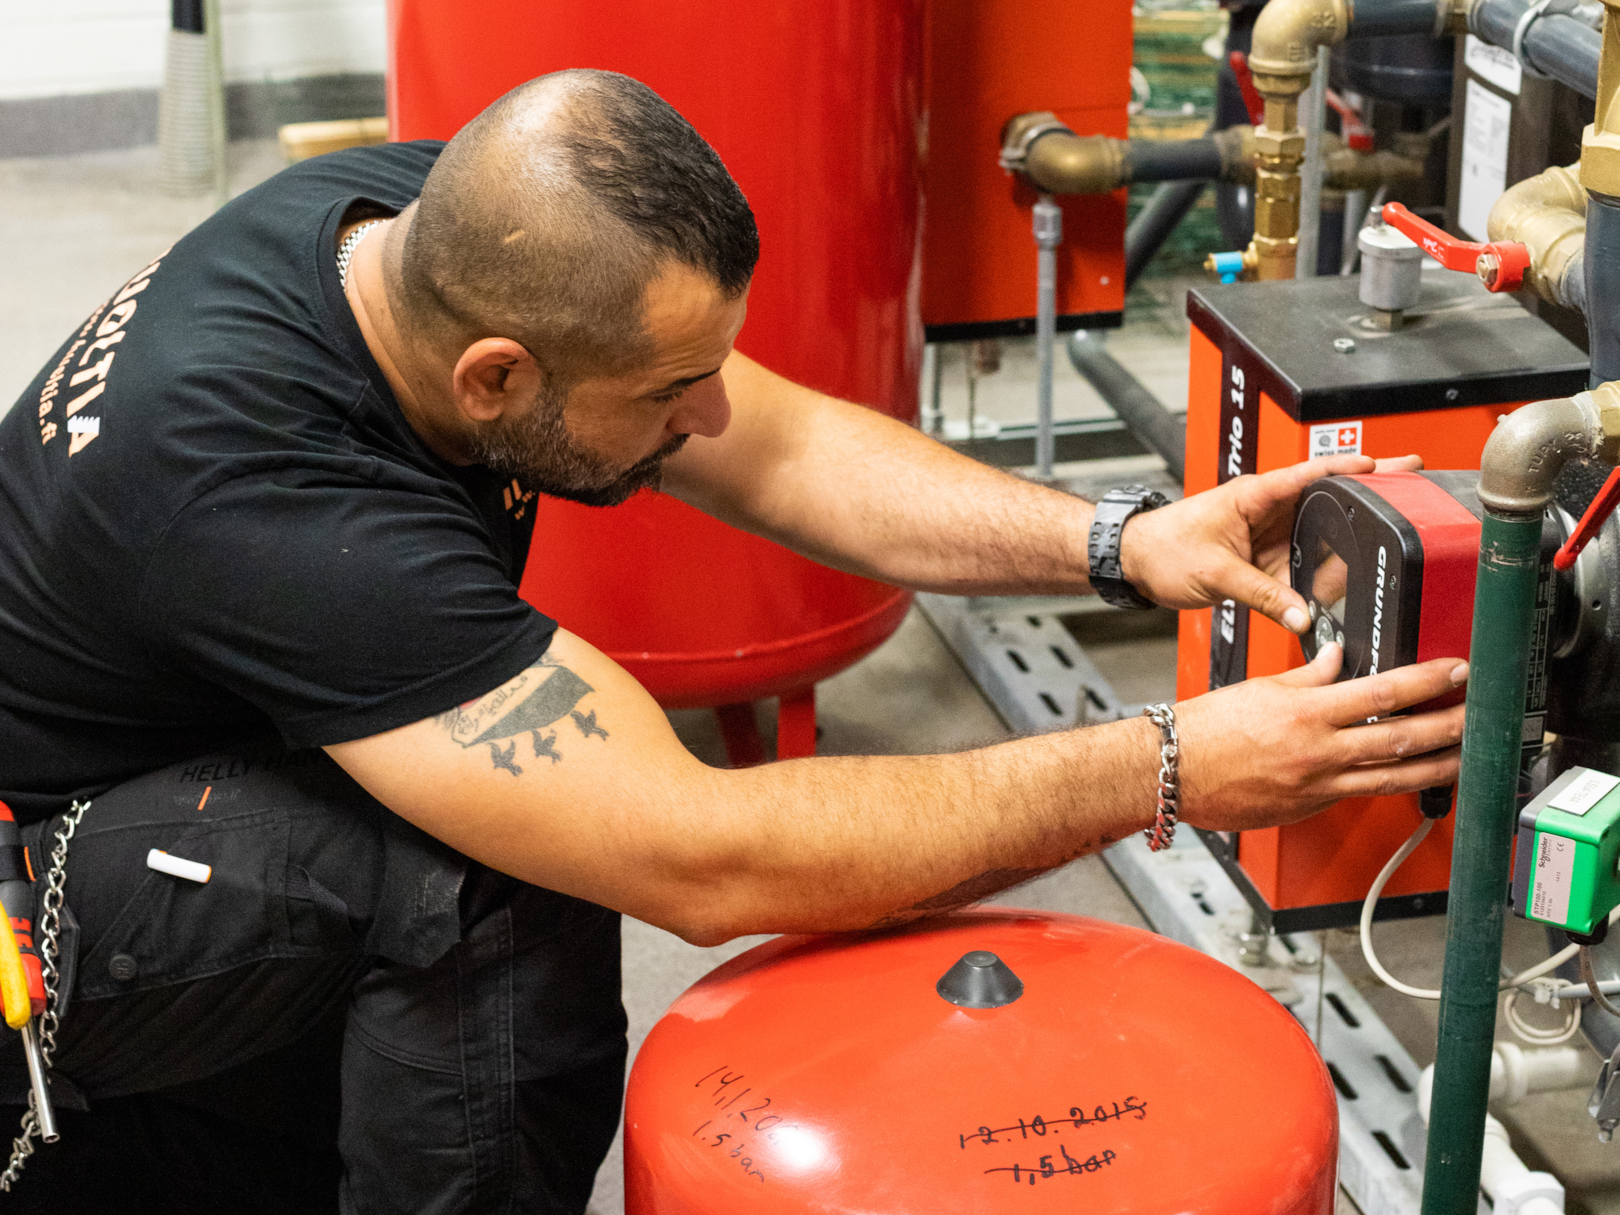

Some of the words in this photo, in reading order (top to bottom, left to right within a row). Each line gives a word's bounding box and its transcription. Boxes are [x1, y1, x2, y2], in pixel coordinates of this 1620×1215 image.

[1231, 365, 1246, 410] 15
[1227, 415, 1244, 476] Trio
[1528, 438, 1558, 473] TUPY
[178, 756, 257, 784] HELLY
[1538, 836, 1551, 869] Schneider
